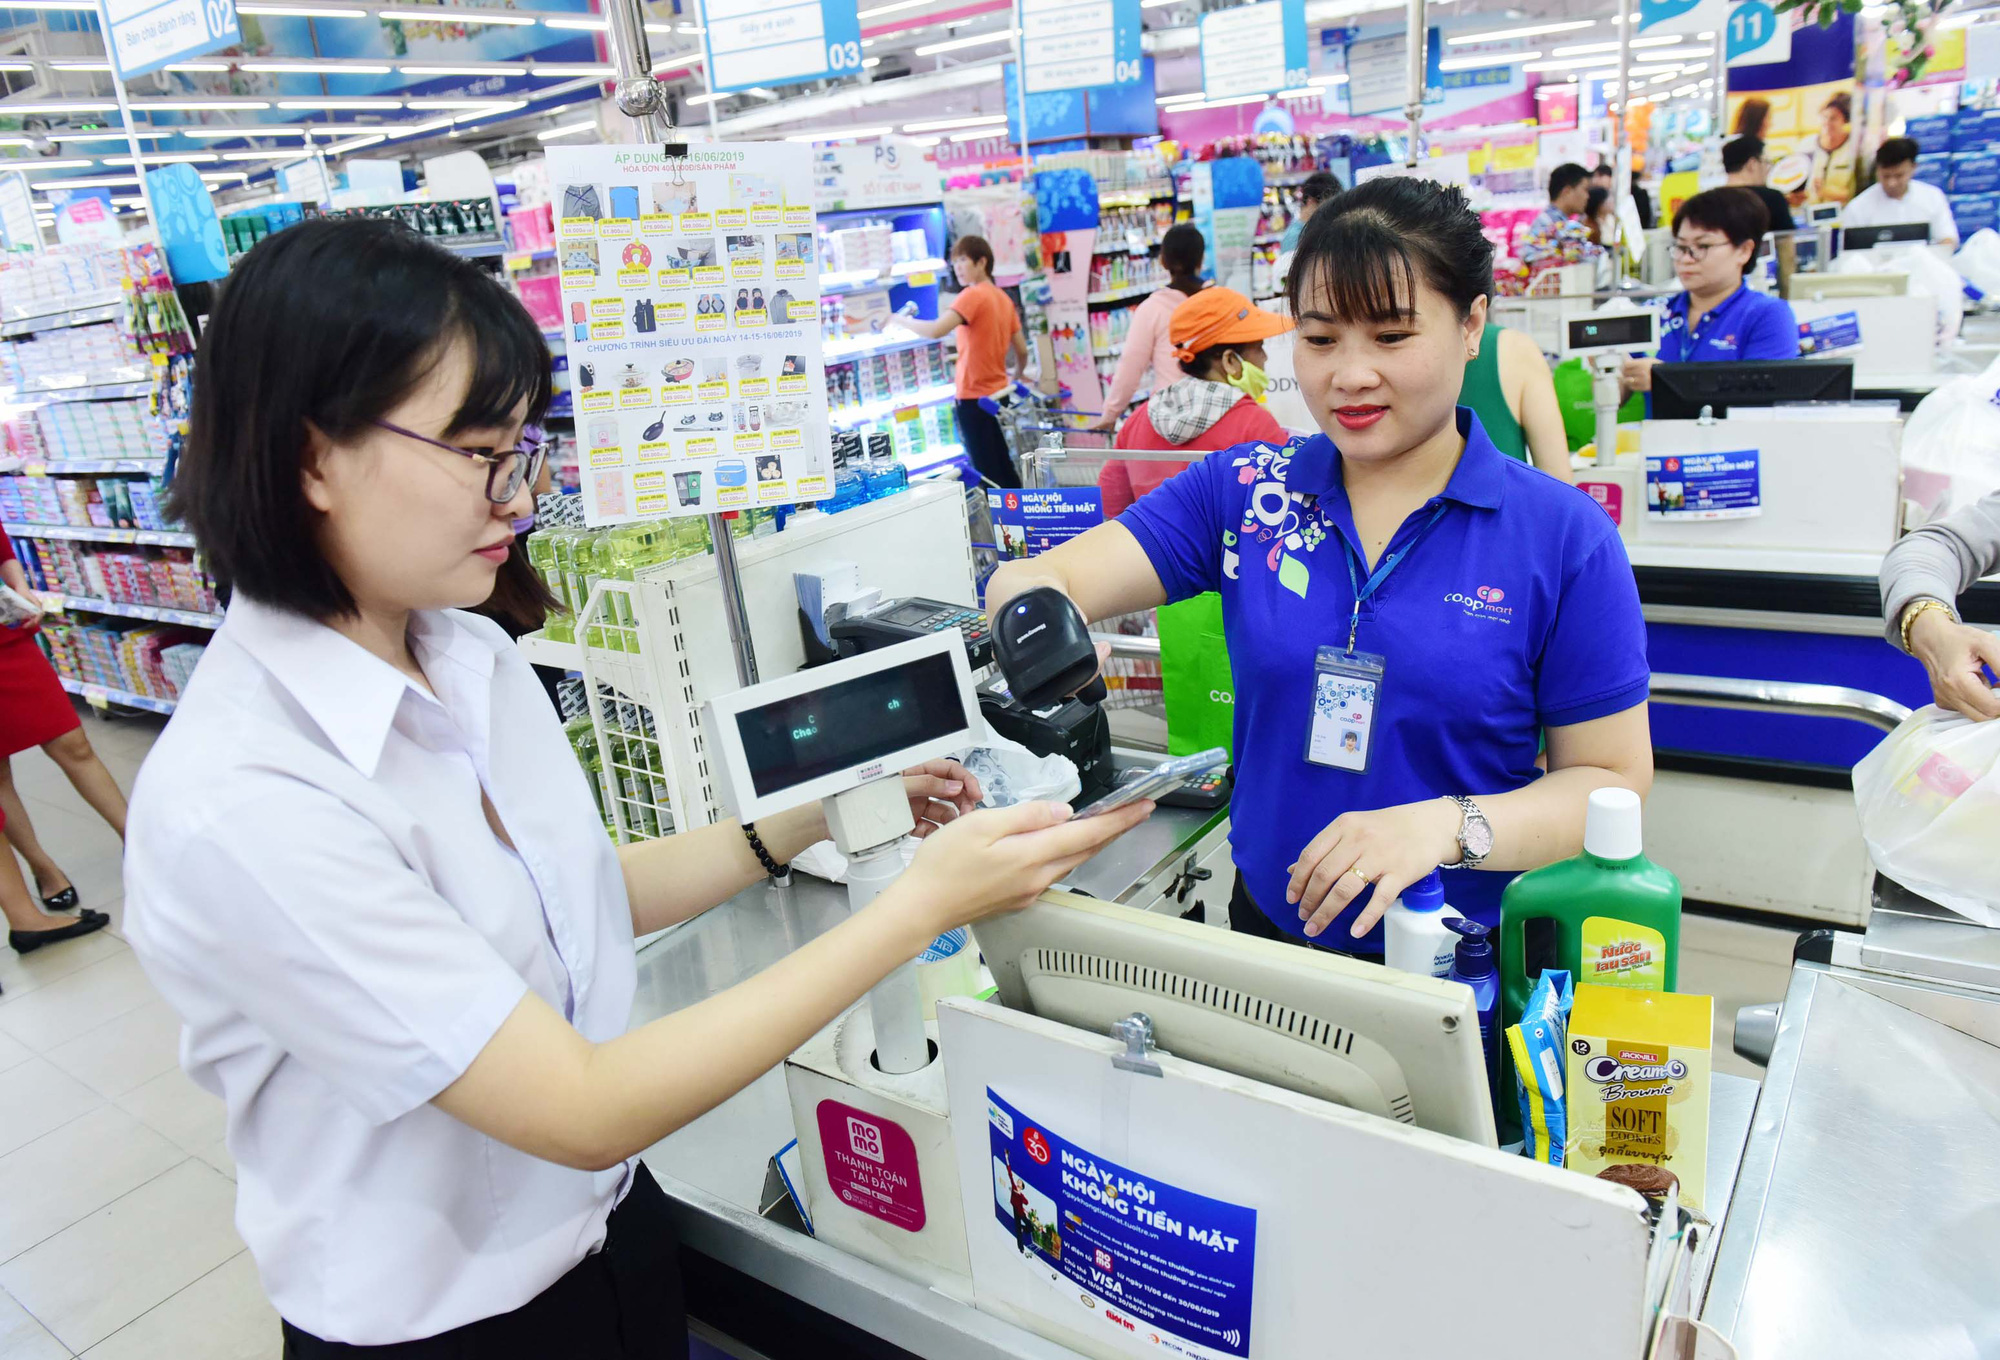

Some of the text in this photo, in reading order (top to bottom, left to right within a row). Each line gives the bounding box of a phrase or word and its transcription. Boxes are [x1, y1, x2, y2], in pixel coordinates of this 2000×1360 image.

[207, 0, 237, 38] 02
[1731, 12, 1762, 42] 11
[828, 41, 860, 70] 03
[1116, 60, 1141, 82] 04
[1286, 68, 1308, 86] 05
[614, 152, 630, 164] ÁP
[623, 164, 640, 173] HÓA
[642, 164, 660, 172] ĐƠN
[587, 330, 802, 352] CHƯƠNG TRÌNH SIÊU ƯU ĐÃI NGÀY 14-15-16/06/2019
[1022, 492, 1062, 504] NGÀY HỘI
[1023, 502, 1096, 514] KHÔNG TIỀN MẶT
[888, 699, 900, 710] ch
[808, 714, 815, 724] C
[1601, 941, 1642, 958] Nước
[1621, 950, 1652, 967] sàn
[1574, 1042, 1588, 1051] 12
[1600, 1084, 1674, 1102] Brownie
[1611, 1106, 1662, 1134] SOFT
[1610, 1131, 1662, 1145] COOKIES
[1028, 1137, 1048, 1162] 30
[834, 1150, 874, 1174] THANH
[876, 1166, 908, 1188] TOÁN
[1062, 1149, 1156, 1206] NGÀY HỘI
[850, 1168, 868, 1184] TẠI
[871, 1176, 894, 1194] ĐÂY
[1062, 1170, 1240, 1253] KHÔNG TIỀN MẶT
[1089, 1266, 1123, 1296] VISA
[1167, 1312, 1186, 1324] thanh
[1126, 1276, 1142, 1289] ngày
[1144, 1284, 1162, 1297] 11/06
[1162, 1292, 1176, 1303] đến
[1178, 1300, 1220, 1318] 30/06/2019
[1118, 1296, 1155, 1319] 30/06/2019
